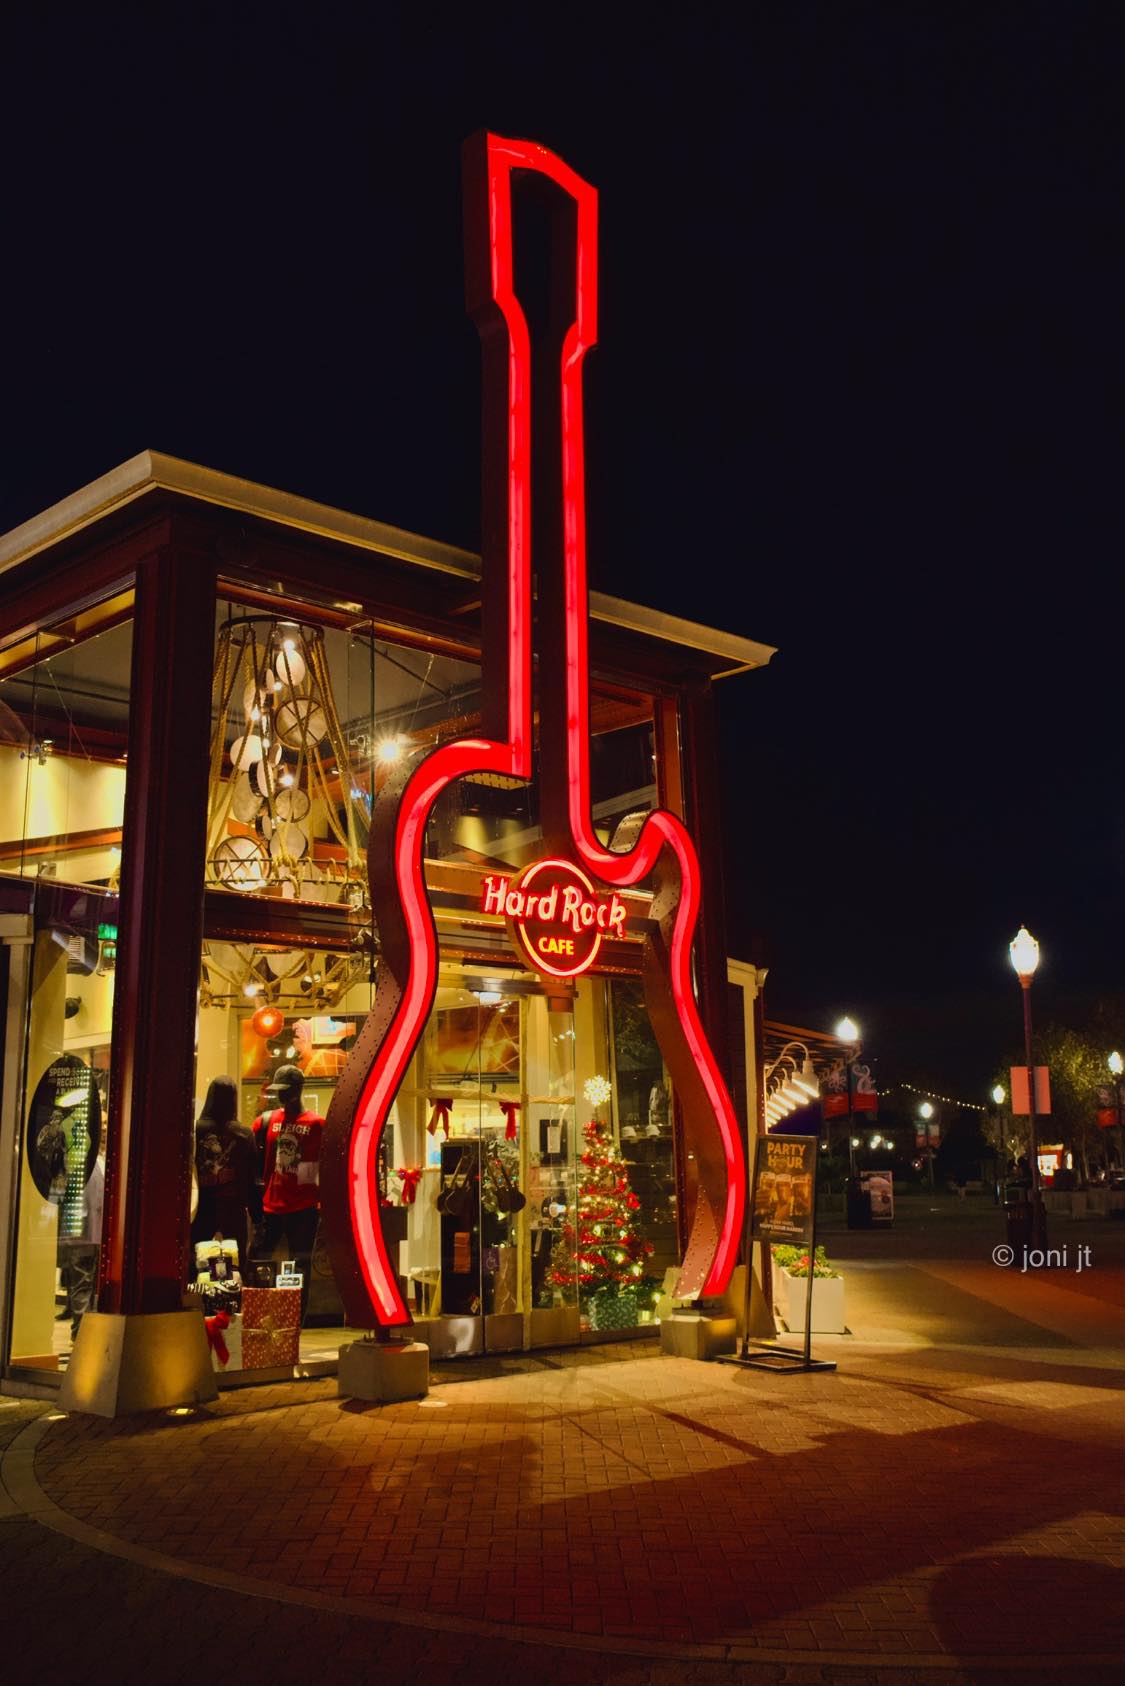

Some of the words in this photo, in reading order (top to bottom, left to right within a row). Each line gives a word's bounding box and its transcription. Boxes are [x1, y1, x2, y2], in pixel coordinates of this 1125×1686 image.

[484, 876, 558, 921] Hard
[562, 885, 627, 938] Rock
[538, 936, 575, 956] CAFE
[49, 1067, 70, 1077] SPEND
[271, 1122, 311, 1135] SLEIGH
[767, 1142, 806, 1156] PARTY
